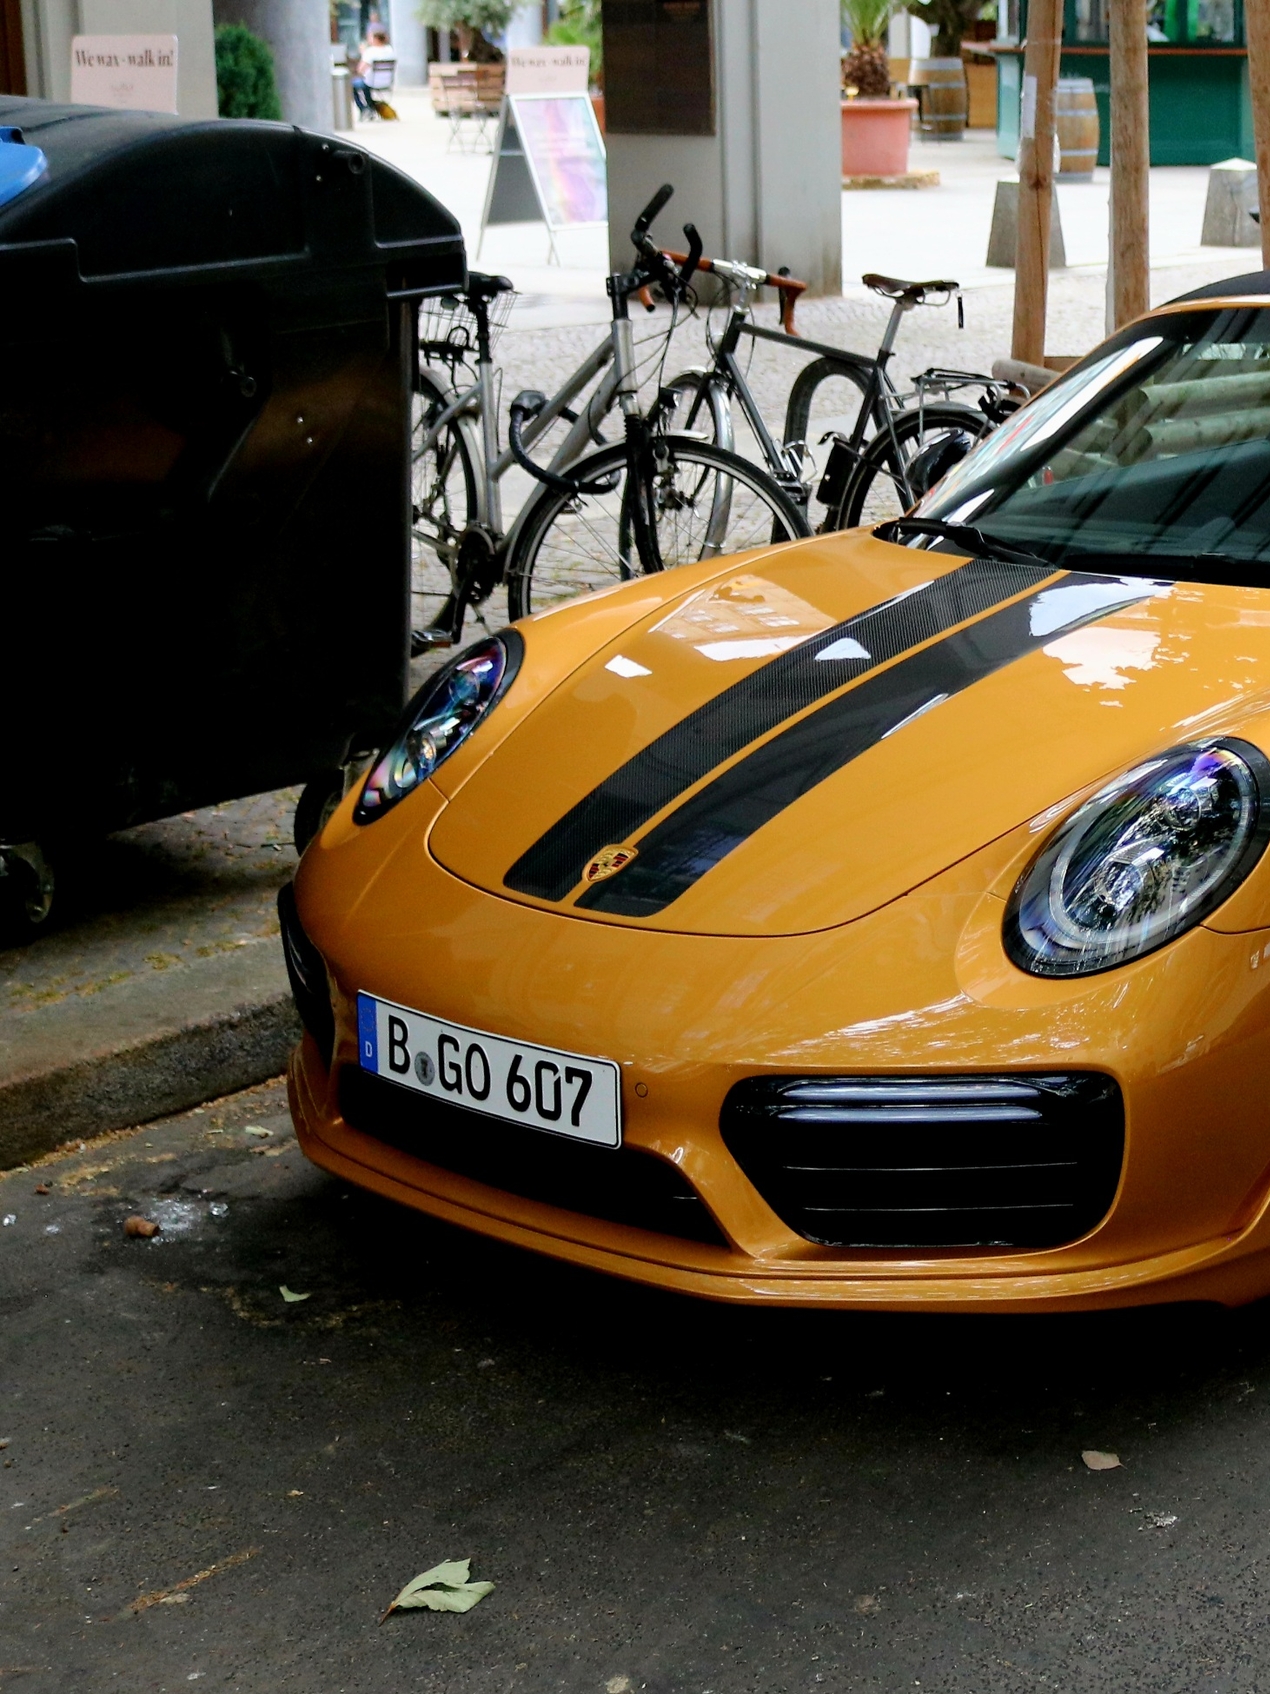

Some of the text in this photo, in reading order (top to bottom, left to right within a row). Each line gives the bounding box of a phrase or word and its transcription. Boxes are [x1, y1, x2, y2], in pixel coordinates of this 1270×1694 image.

[76, 50, 95, 67] We
[127, 49, 156, 67] walk
[365, 1014, 593, 1127] D B GO 607
